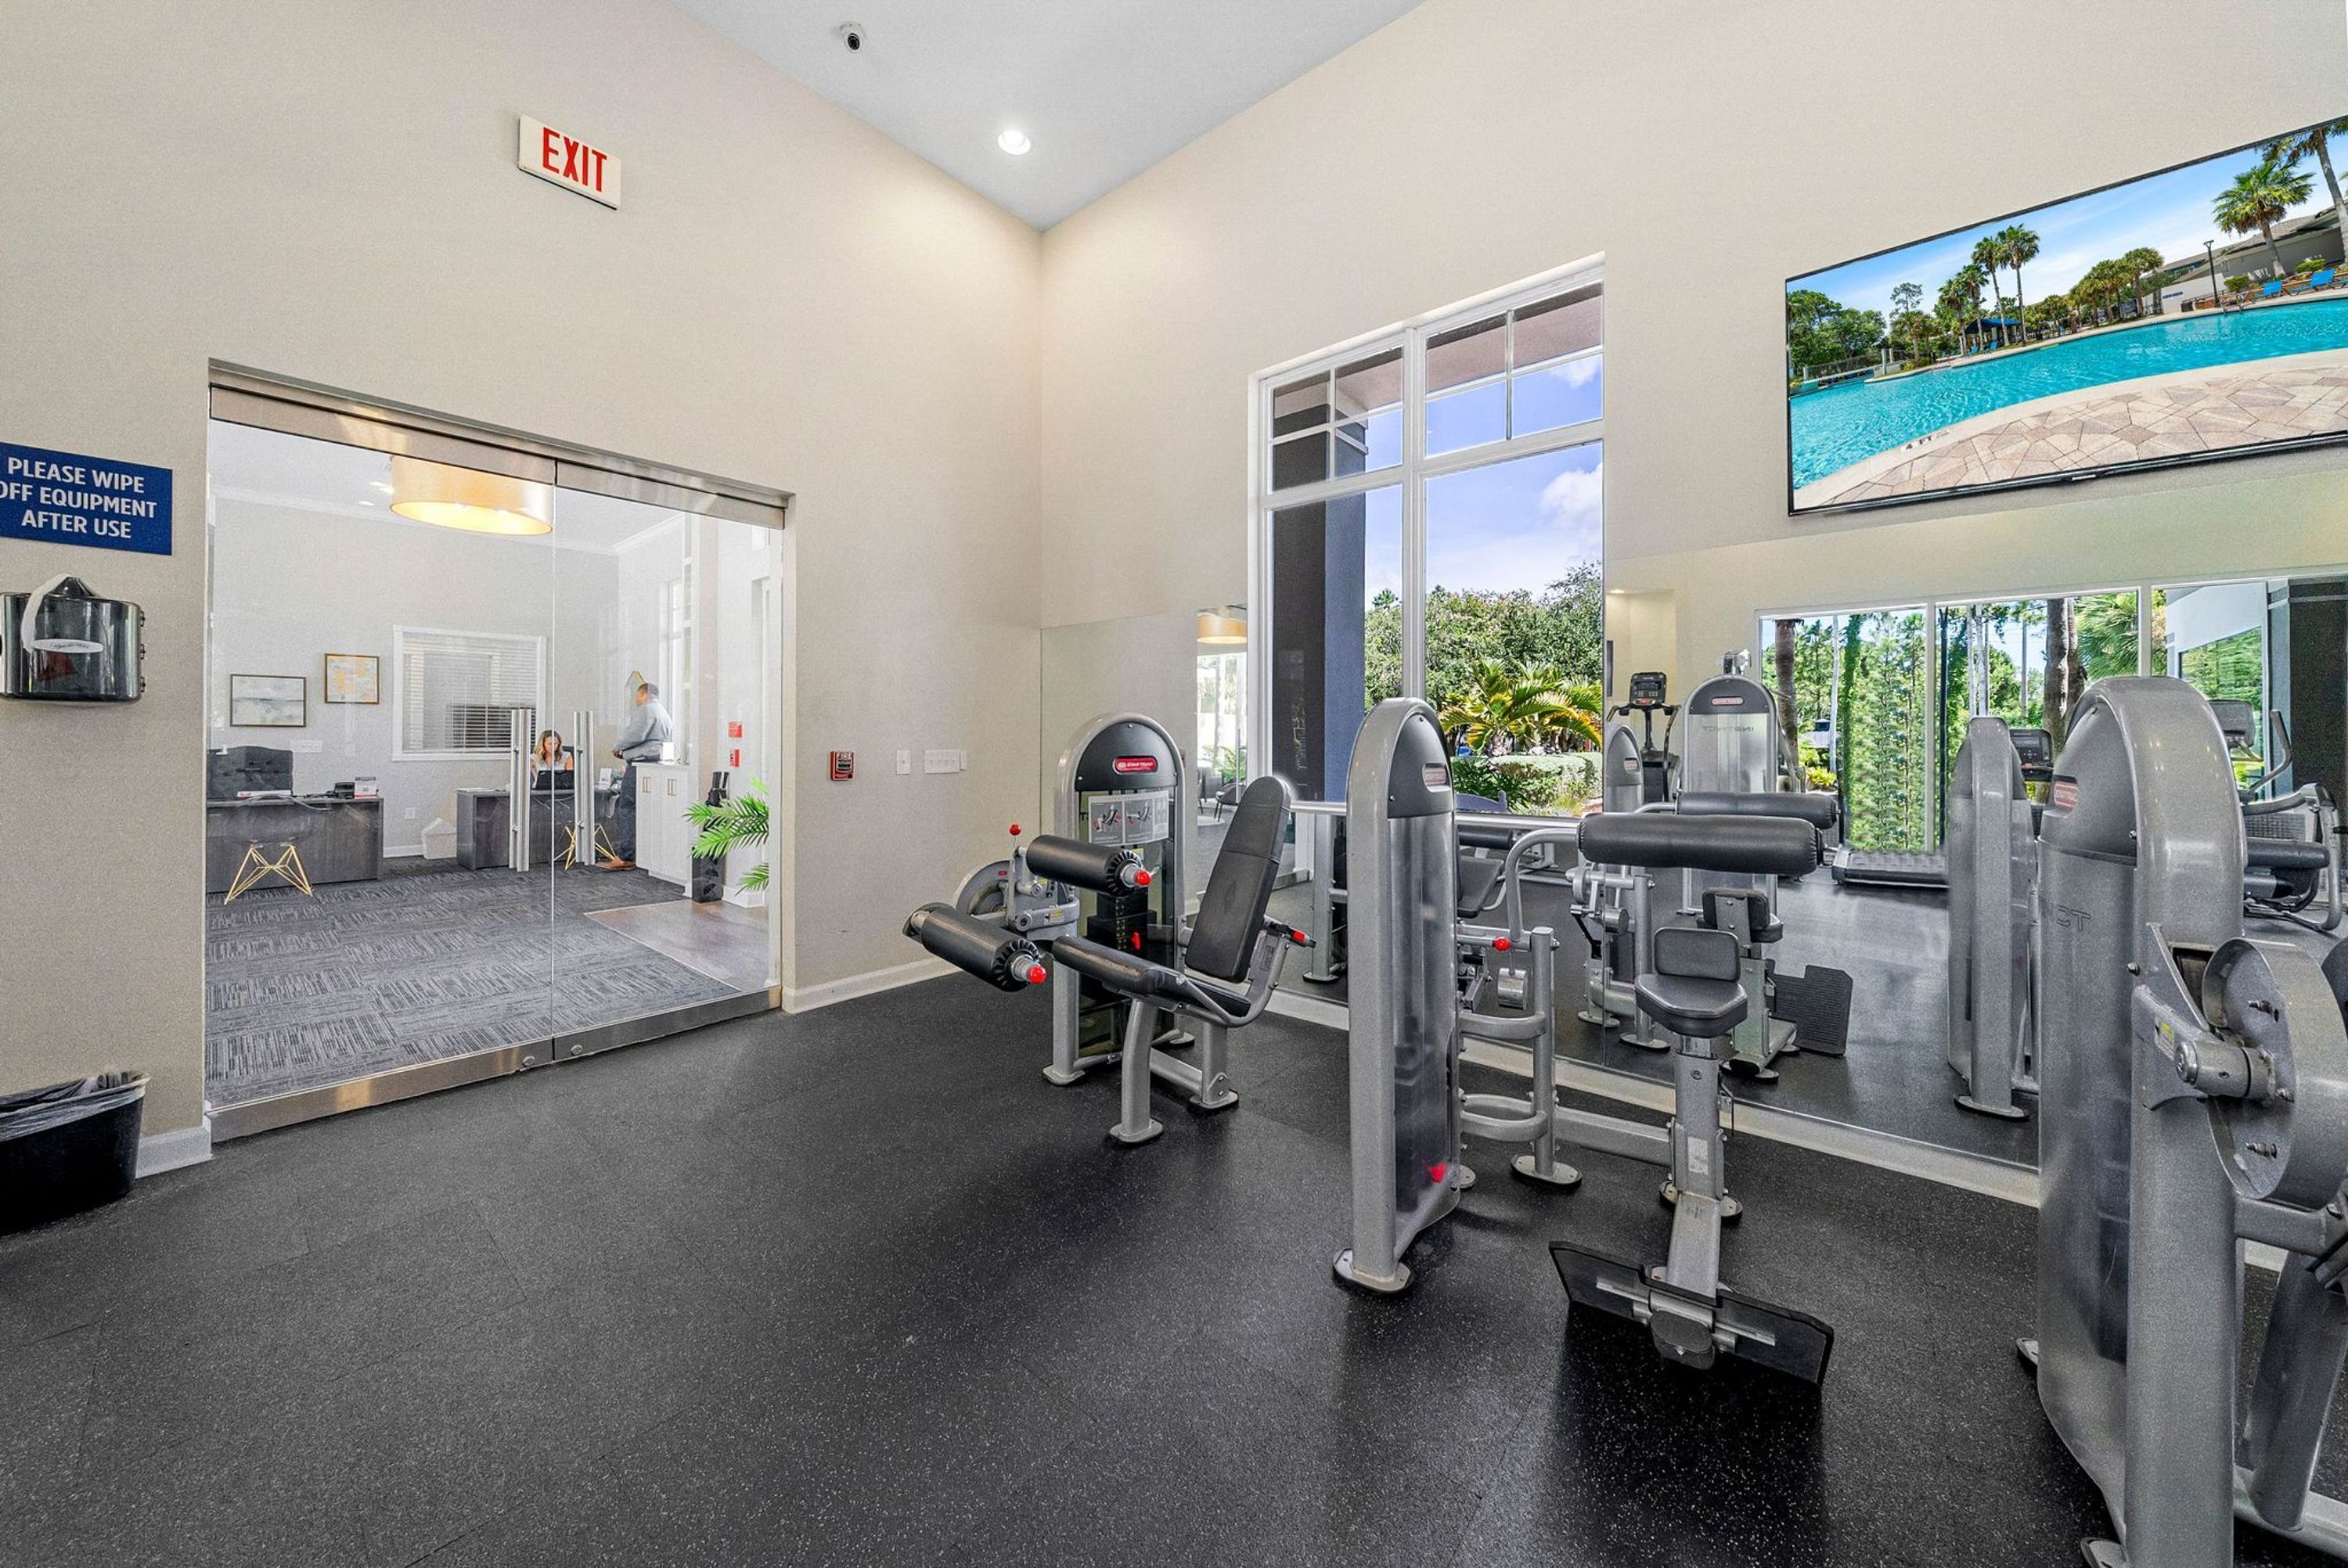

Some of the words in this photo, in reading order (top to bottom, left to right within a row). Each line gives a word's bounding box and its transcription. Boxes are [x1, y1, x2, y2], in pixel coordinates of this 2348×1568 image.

[542, 127, 607, 192] EXIT
[8, 457, 86, 485] PLEASE
[92, 469, 144, 494] WIPE
[40, 486, 157, 518] EQUIPMENT
[21, 509, 88, 534] AFTER
[94, 518, 131, 538] USE
